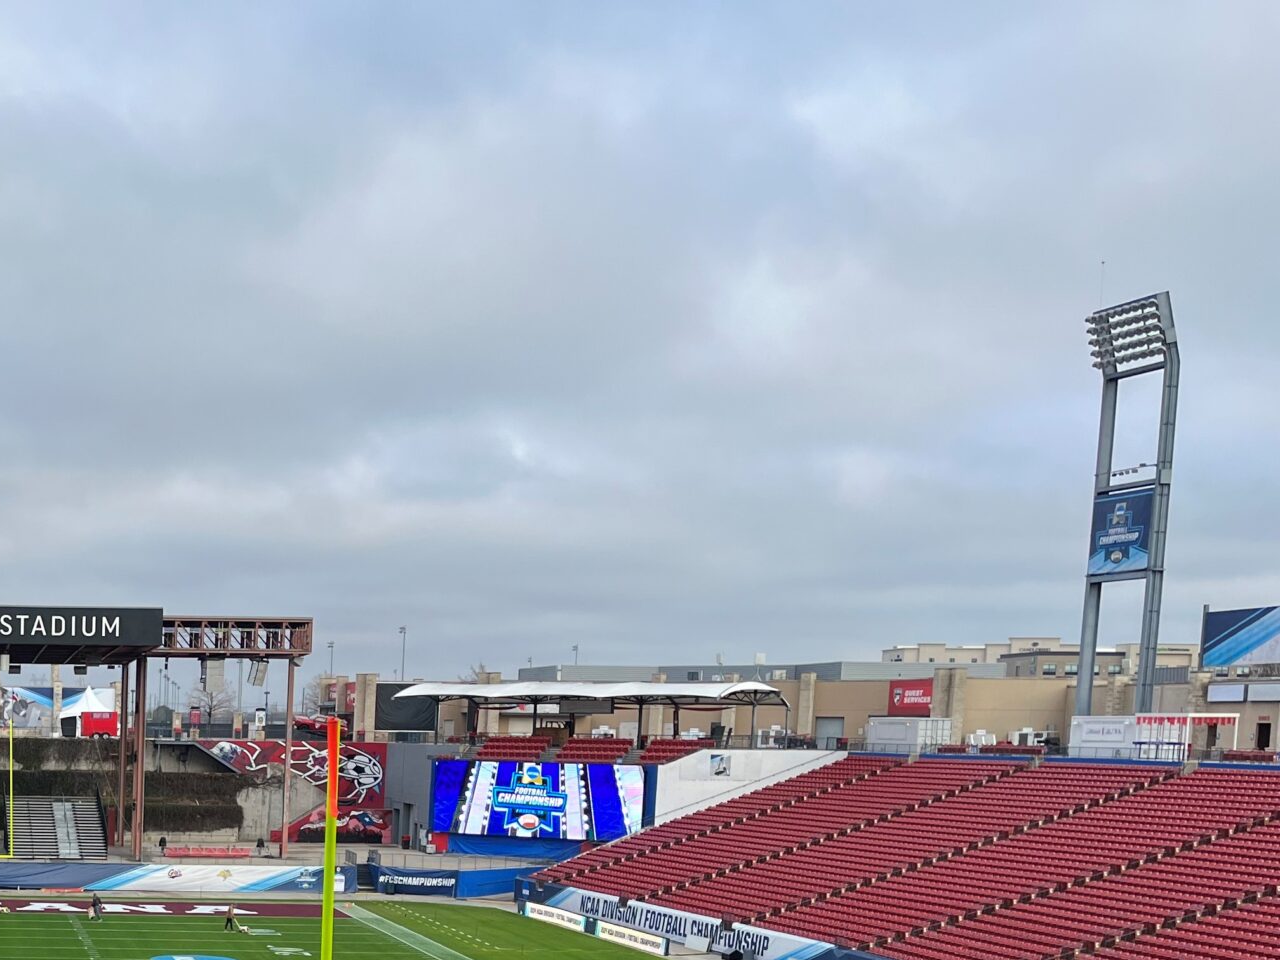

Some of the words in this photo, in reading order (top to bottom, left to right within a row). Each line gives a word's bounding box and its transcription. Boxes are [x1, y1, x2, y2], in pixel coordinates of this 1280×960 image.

[0, 614, 121, 637] STADIUM
[904, 689, 924, 697] GUEST
[903, 696, 931, 704] SERVICES
[514, 786, 548, 797] FOOTBALL
[497, 792, 564, 808] CHAMPIONSHIP
[378, 875, 456, 888] #FCSCHAMPIONSHIP
[580, 894, 600, 917] NCAA
[601, 899, 638, 926] DIVISION
[644, 909, 688, 938] FOOTBALL
[690, 920, 770, 956] CHAMPIONSHIP
